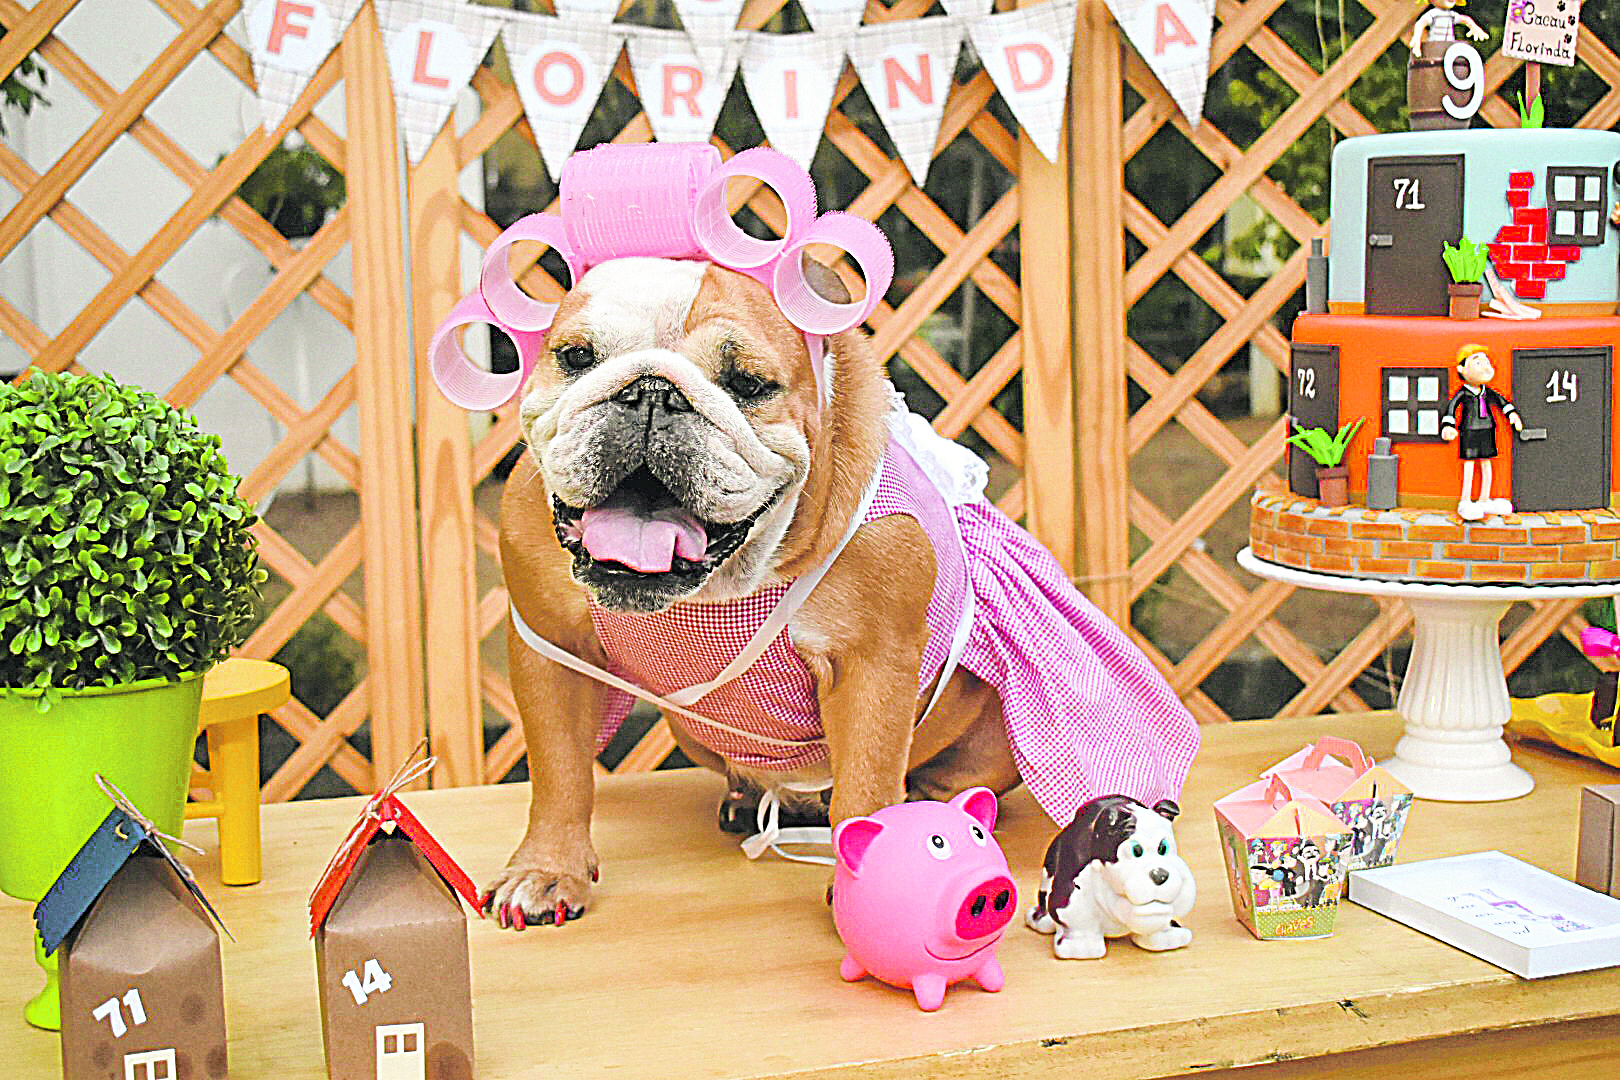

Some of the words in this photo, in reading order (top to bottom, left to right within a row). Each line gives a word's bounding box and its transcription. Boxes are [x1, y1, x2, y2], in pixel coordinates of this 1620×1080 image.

[1522, 1, 1566, 29] Cacau
[1442, 42, 1484, 119] 9
[1393, 178, 1425, 209] 71
[1297, 367, 1316, 399] 72
[1546, 370, 1577, 402] 14
[341, 958, 392, 1006] 14
[92, 988, 146, 1038] 71
